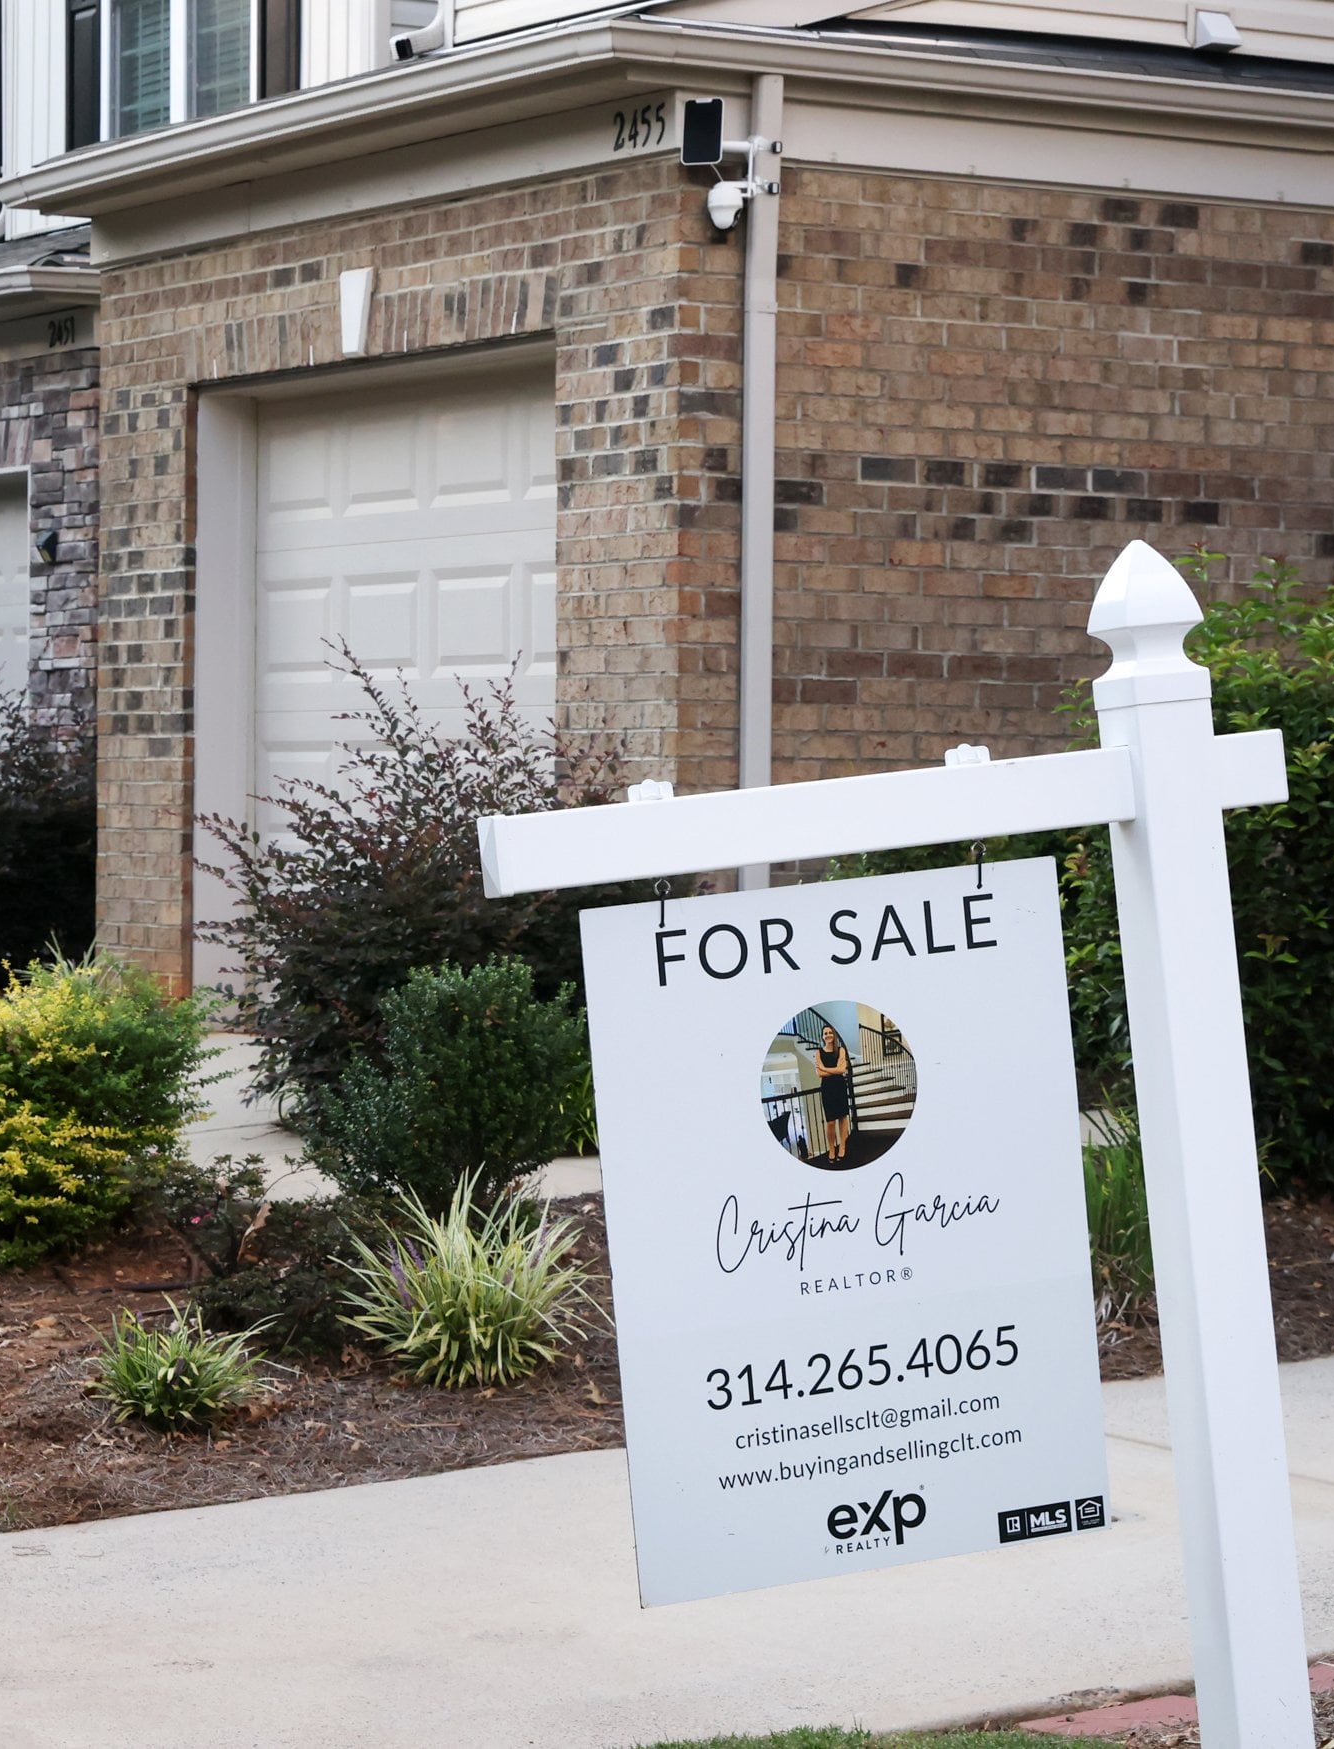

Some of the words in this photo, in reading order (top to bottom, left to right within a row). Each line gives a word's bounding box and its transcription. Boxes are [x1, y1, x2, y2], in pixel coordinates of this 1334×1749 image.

[613, 102, 665, 151] 2455
[48, 315, 75, 348] 2451
[654, 917, 800, 987] FOR
[829, 893, 998, 965] SALE
[716, 1192, 860, 1274] Cristina
[875, 1172, 1000, 1256] Garcia
[706, 1324, 1019, 1411] 314.265.4065
[735, 1394, 1001, 1450] cristinasellsclt@gmail.com
[718, 1427, 1023, 1490] www.buyingandsellingclt.com
[836, 1536, 890, 1555] REALTY
[1029, 1508, 1067, 1528] MLS
